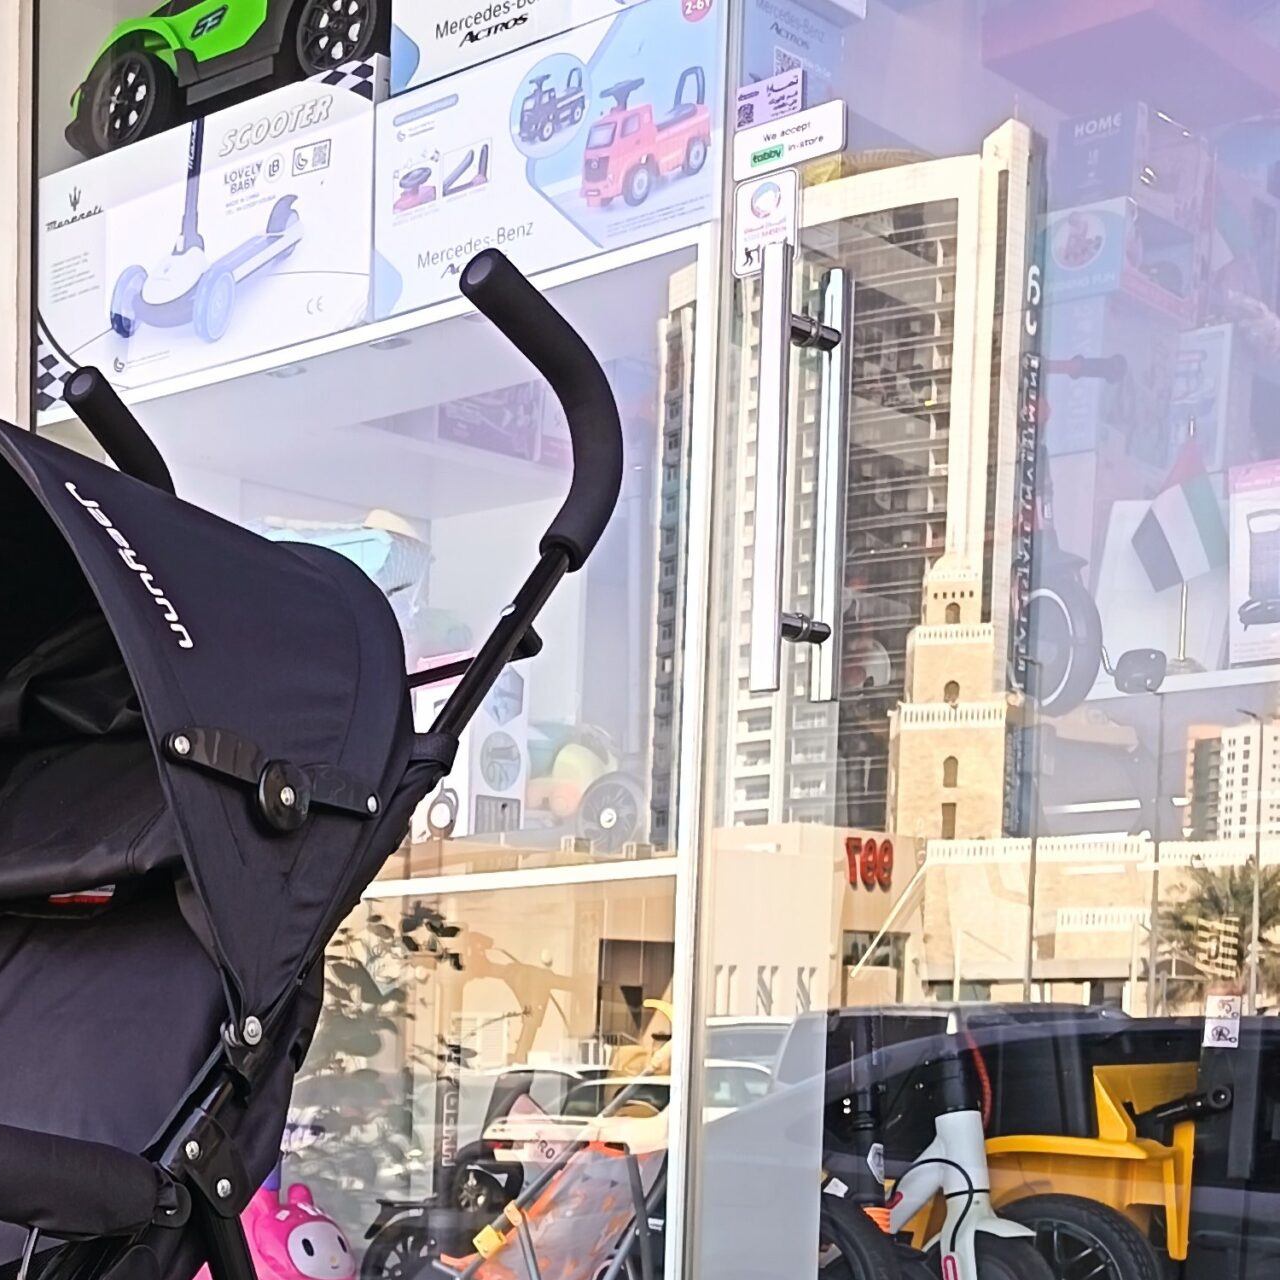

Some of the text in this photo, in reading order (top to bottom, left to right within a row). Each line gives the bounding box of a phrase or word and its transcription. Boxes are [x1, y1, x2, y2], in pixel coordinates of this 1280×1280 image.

[458, 12, 529, 48] ACTROS
[219, 94, 334, 158] SCOOTER
[763, 121, 812, 142] We accept
[752, 135, 824, 164] tabby in-store
[224, 159, 264, 185] LOVELY
[417, 221, 534, 269] Mercedes-Benz
